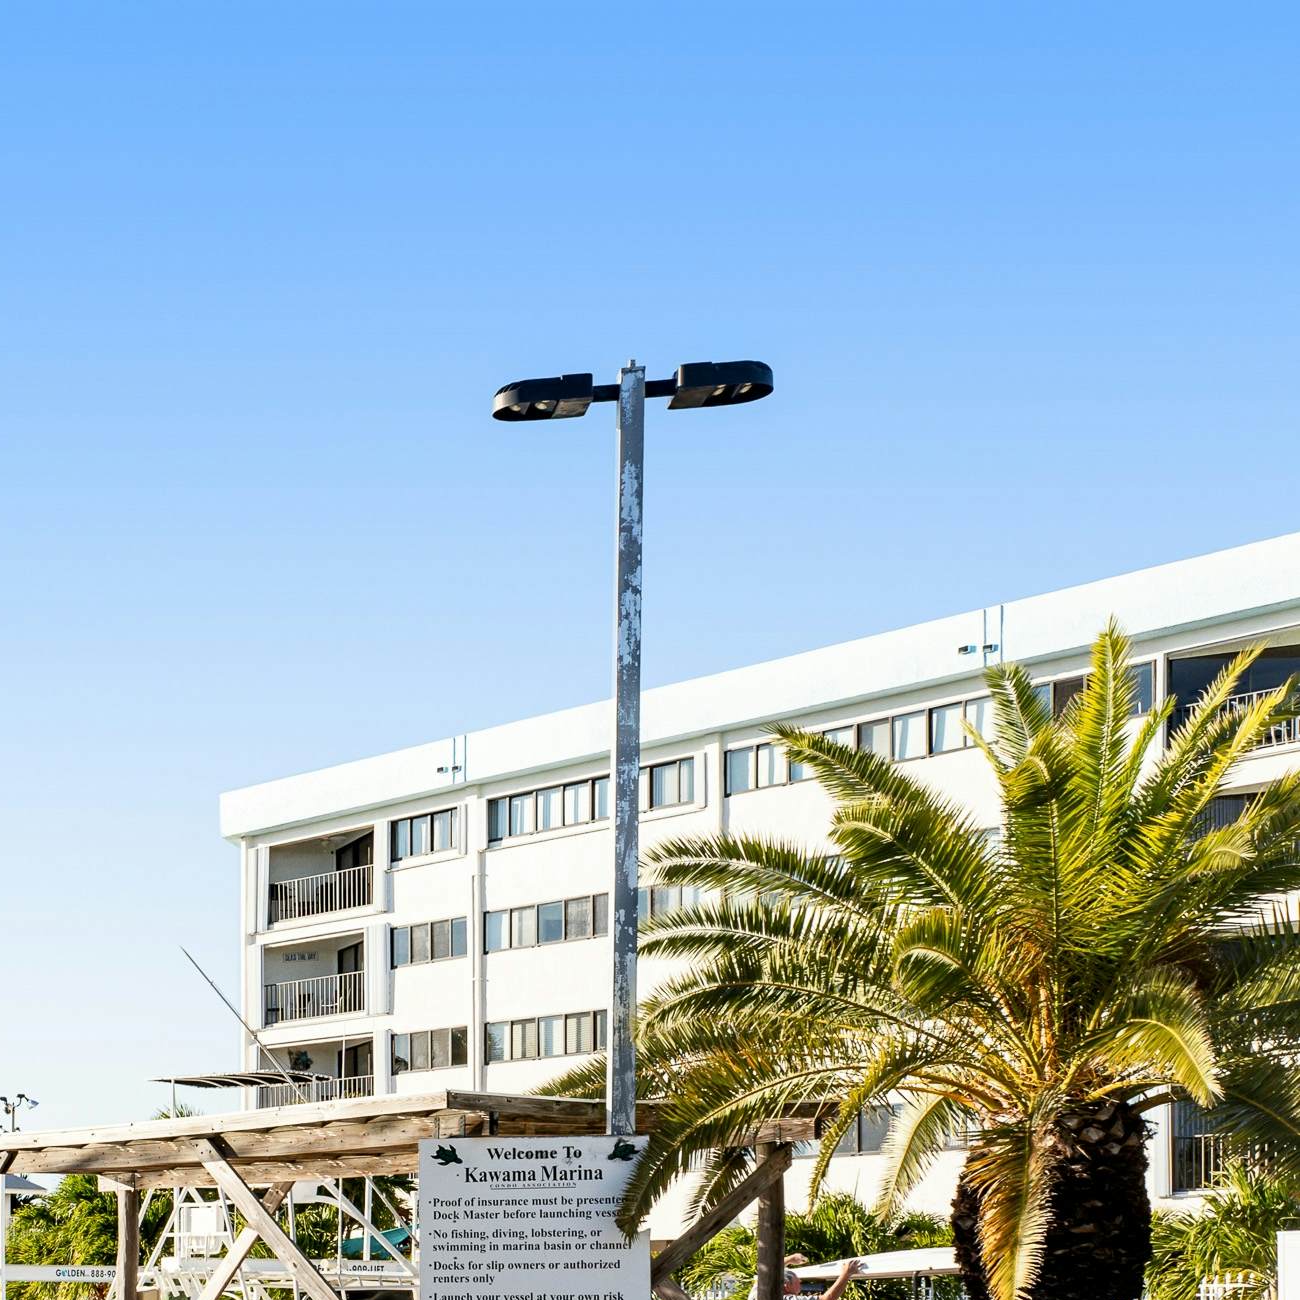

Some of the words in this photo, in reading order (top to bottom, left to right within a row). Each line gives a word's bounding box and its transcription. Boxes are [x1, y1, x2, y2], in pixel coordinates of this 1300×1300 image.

[487, 1147, 557, 1160] Welcome
[562, 1146, 582, 1159] To
[464, 1167, 536, 1183] Kawama
[541, 1165, 603, 1181] Marina
[433, 1197, 462, 1207] Proof
[464, 1197, 475, 1206] of
[477, 1197, 529, 1206] insurance
[532, 1197, 558, 1206] must
[561, 1196, 574, 1205] be
[576, 1196, 624, 1207] presente
[433, 1210, 460, 1220] Dock
[463, 1210, 501, 1220] Master
[503, 1209, 537, 1219] before
[539, 1208, 592, 1220] launching
[433, 1229, 448, 1239] No
[451, 1229, 490, 1240] fishing,
[492, 1229, 528, 1240] diving,
[531, 1228, 588, 1240] lobstering,
[590, 1229, 603, 1238] or
[432, 1242, 487, 1253] swimming
[489, 1241, 499, 1251] in
[502, 1241, 540, 1251] marina
[543, 1241, 572, 1251] basin
[574, 1242, 587, 1250] or
[433, 1260, 465, 1271] Docks
[468, 1260, 484, 1270] for
[486, 1260, 505, 1272] slip
[507, 1262, 546, 1270] owners
[563, 1259, 621, 1270] authorized
[433, 1275, 470, 1283] renters
[472, 1274, 495, 1286] only
[537, 1293, 547, 1300] at
